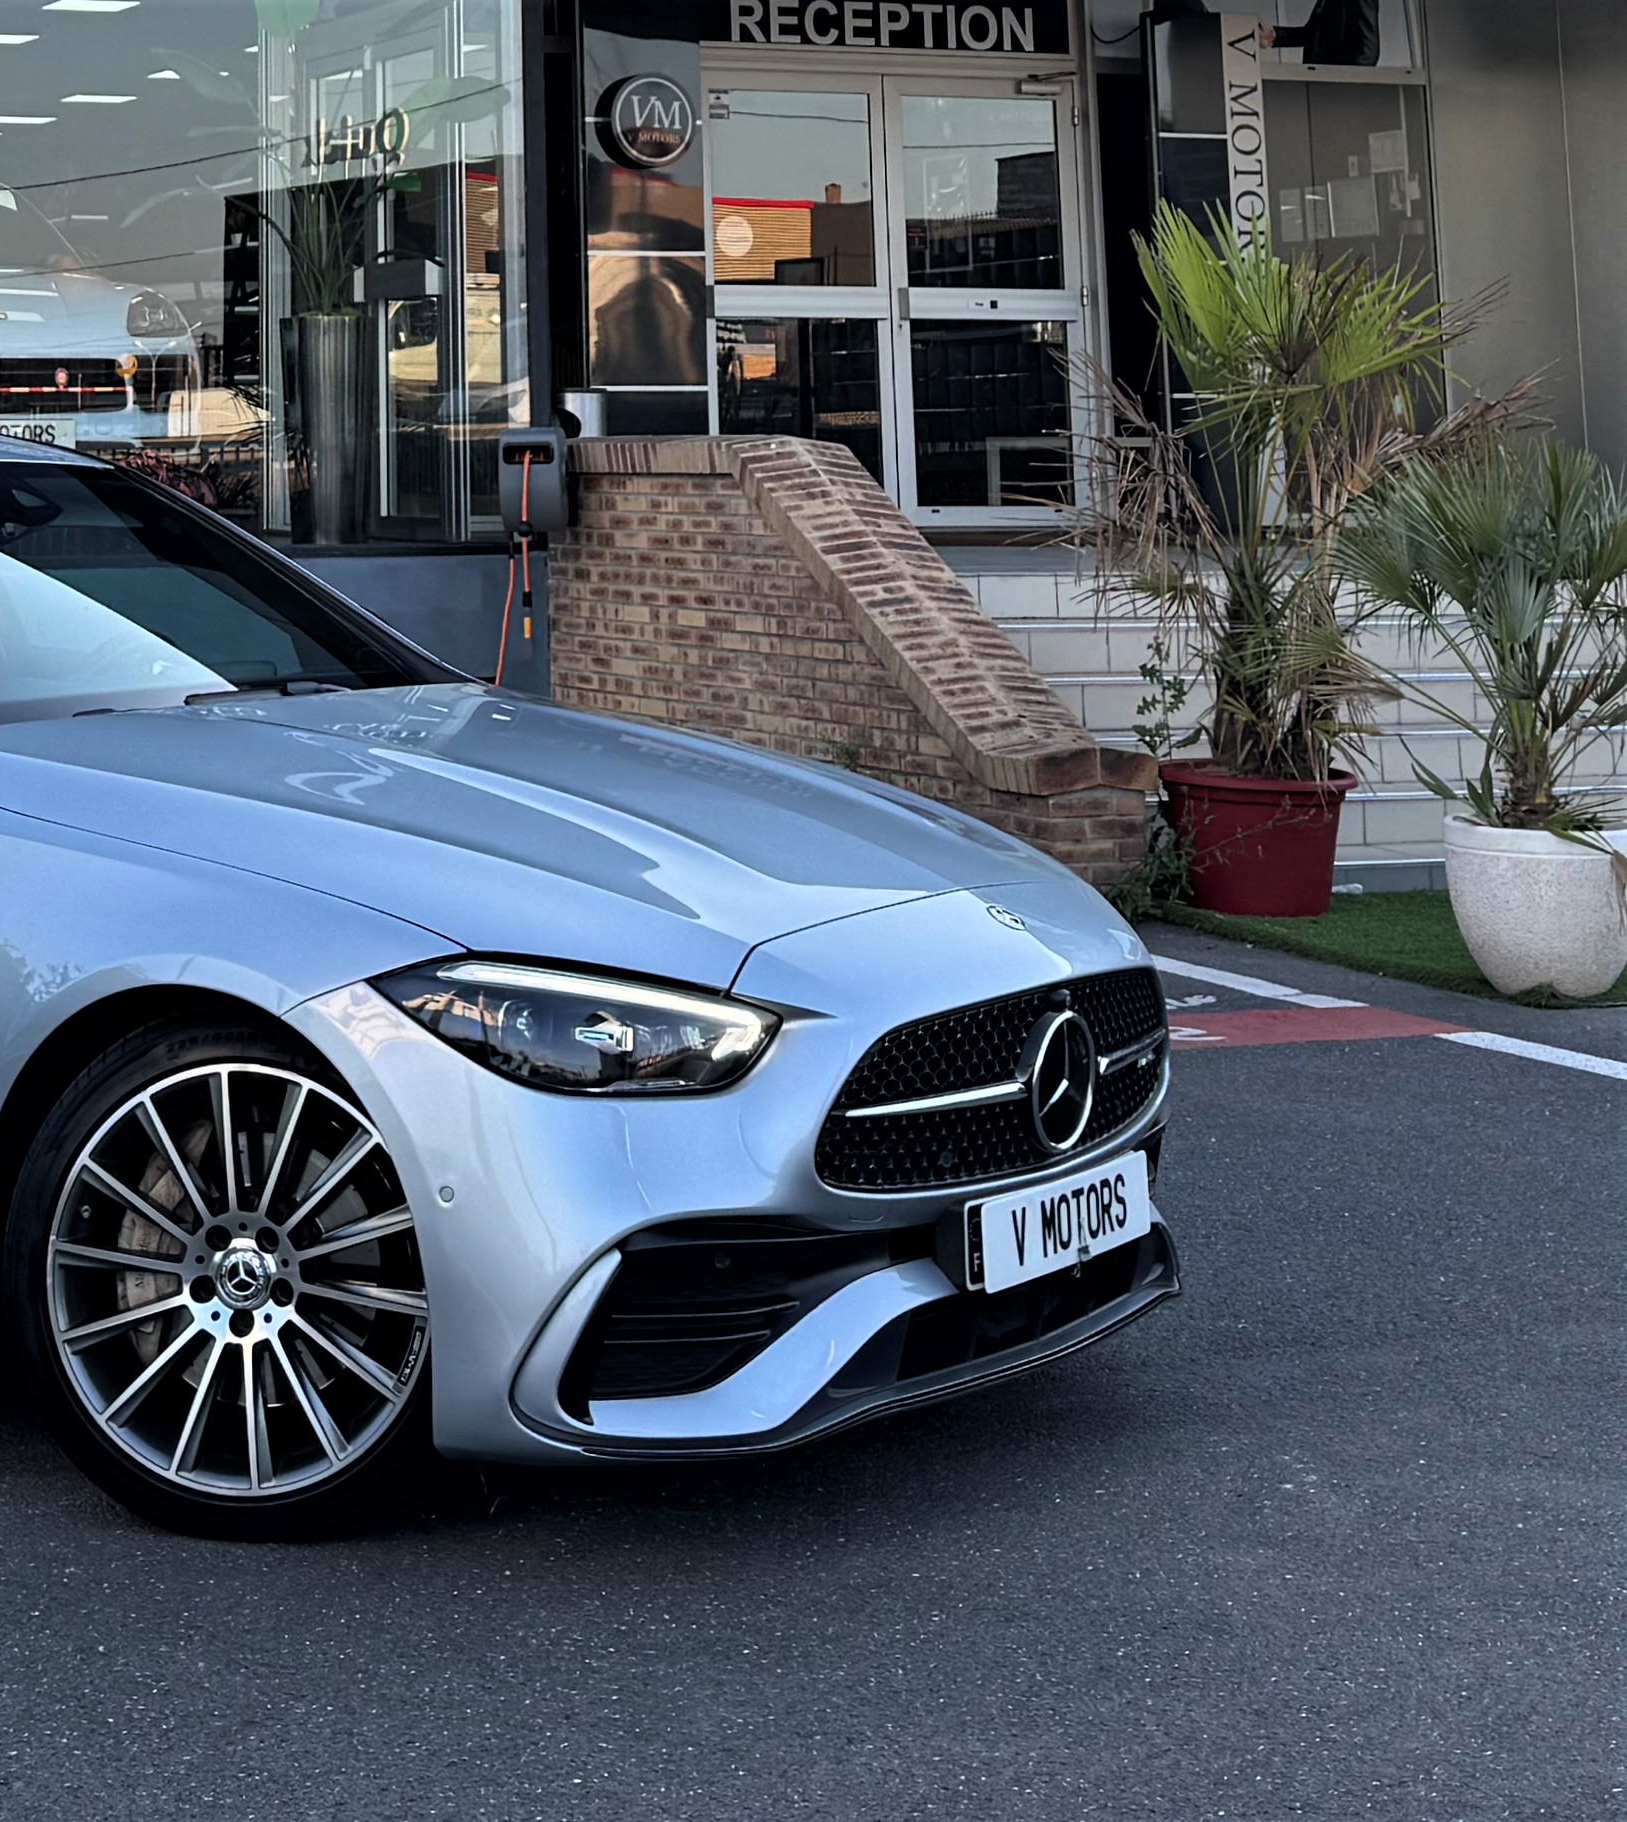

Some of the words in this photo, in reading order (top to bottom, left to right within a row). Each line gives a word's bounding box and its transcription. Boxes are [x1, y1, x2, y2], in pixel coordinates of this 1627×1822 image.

[730, 0, 1034, 51] RECEPTION
[1227, 30, 1257, 62] V
[631, 95, 682, 129] VM
[1229, 80, 1267, 266] MOTOR
[1011, 1205, 1027, 1267] V
[1041, 1173, 1128, 1259] MOTORS
